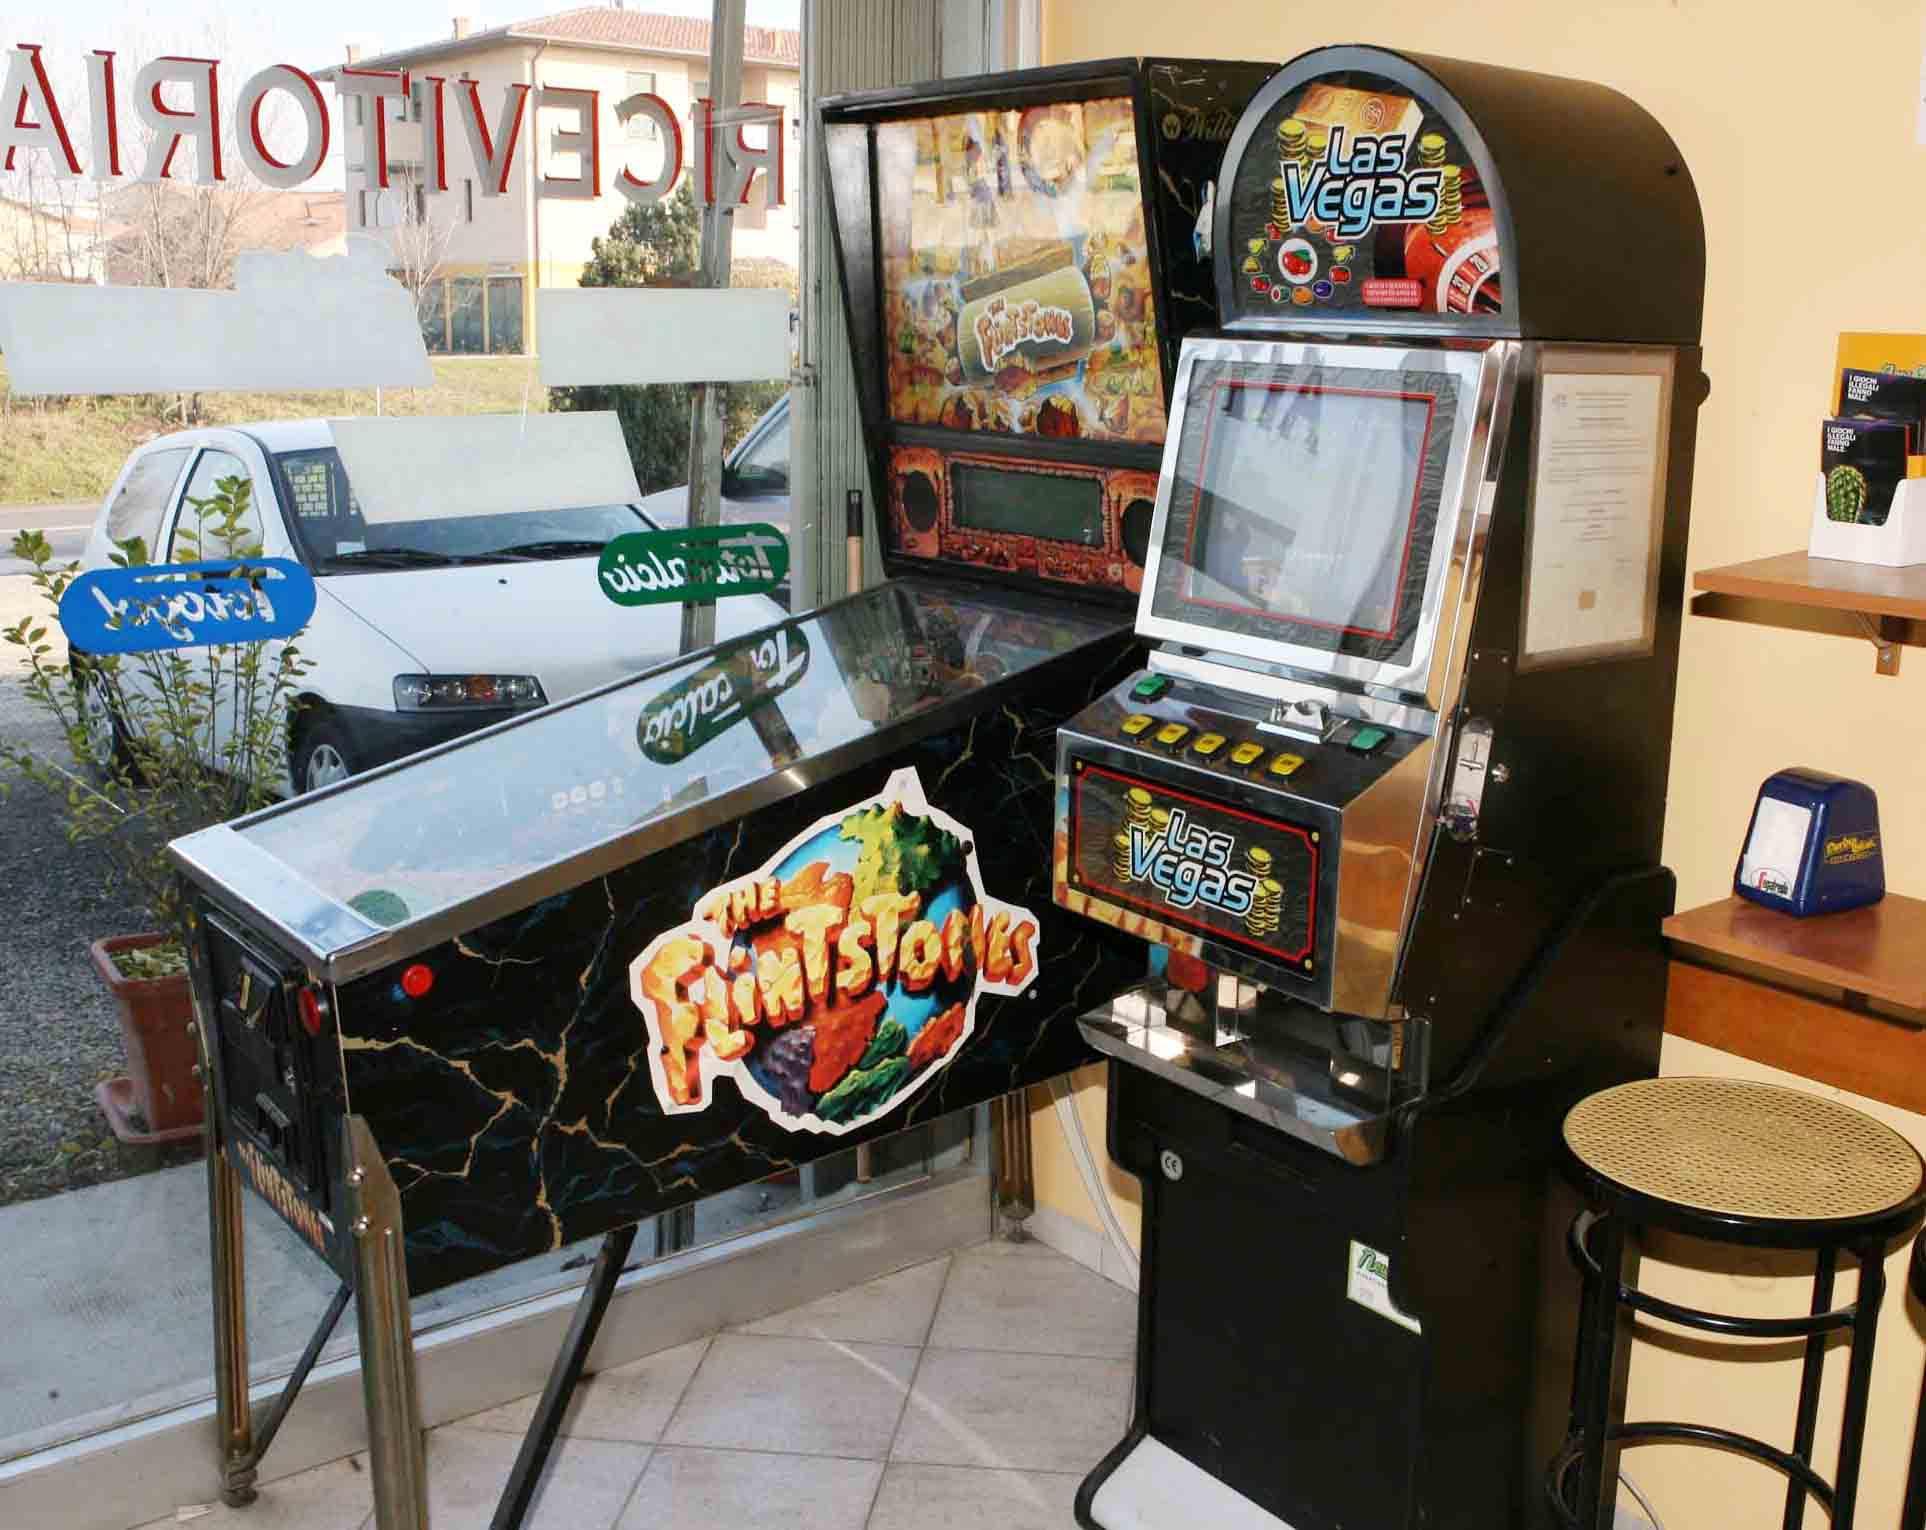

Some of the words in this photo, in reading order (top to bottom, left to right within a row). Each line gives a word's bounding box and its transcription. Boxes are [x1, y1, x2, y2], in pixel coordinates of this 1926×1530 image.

[1326, 126, 1407, 176] Las
[1281, 161, 1445, 239] Vegas
[1167, 808, 1233, 868] Las
[1129, 825, 1260, 916] Vegas
[704, 879, 782, 936] THE
